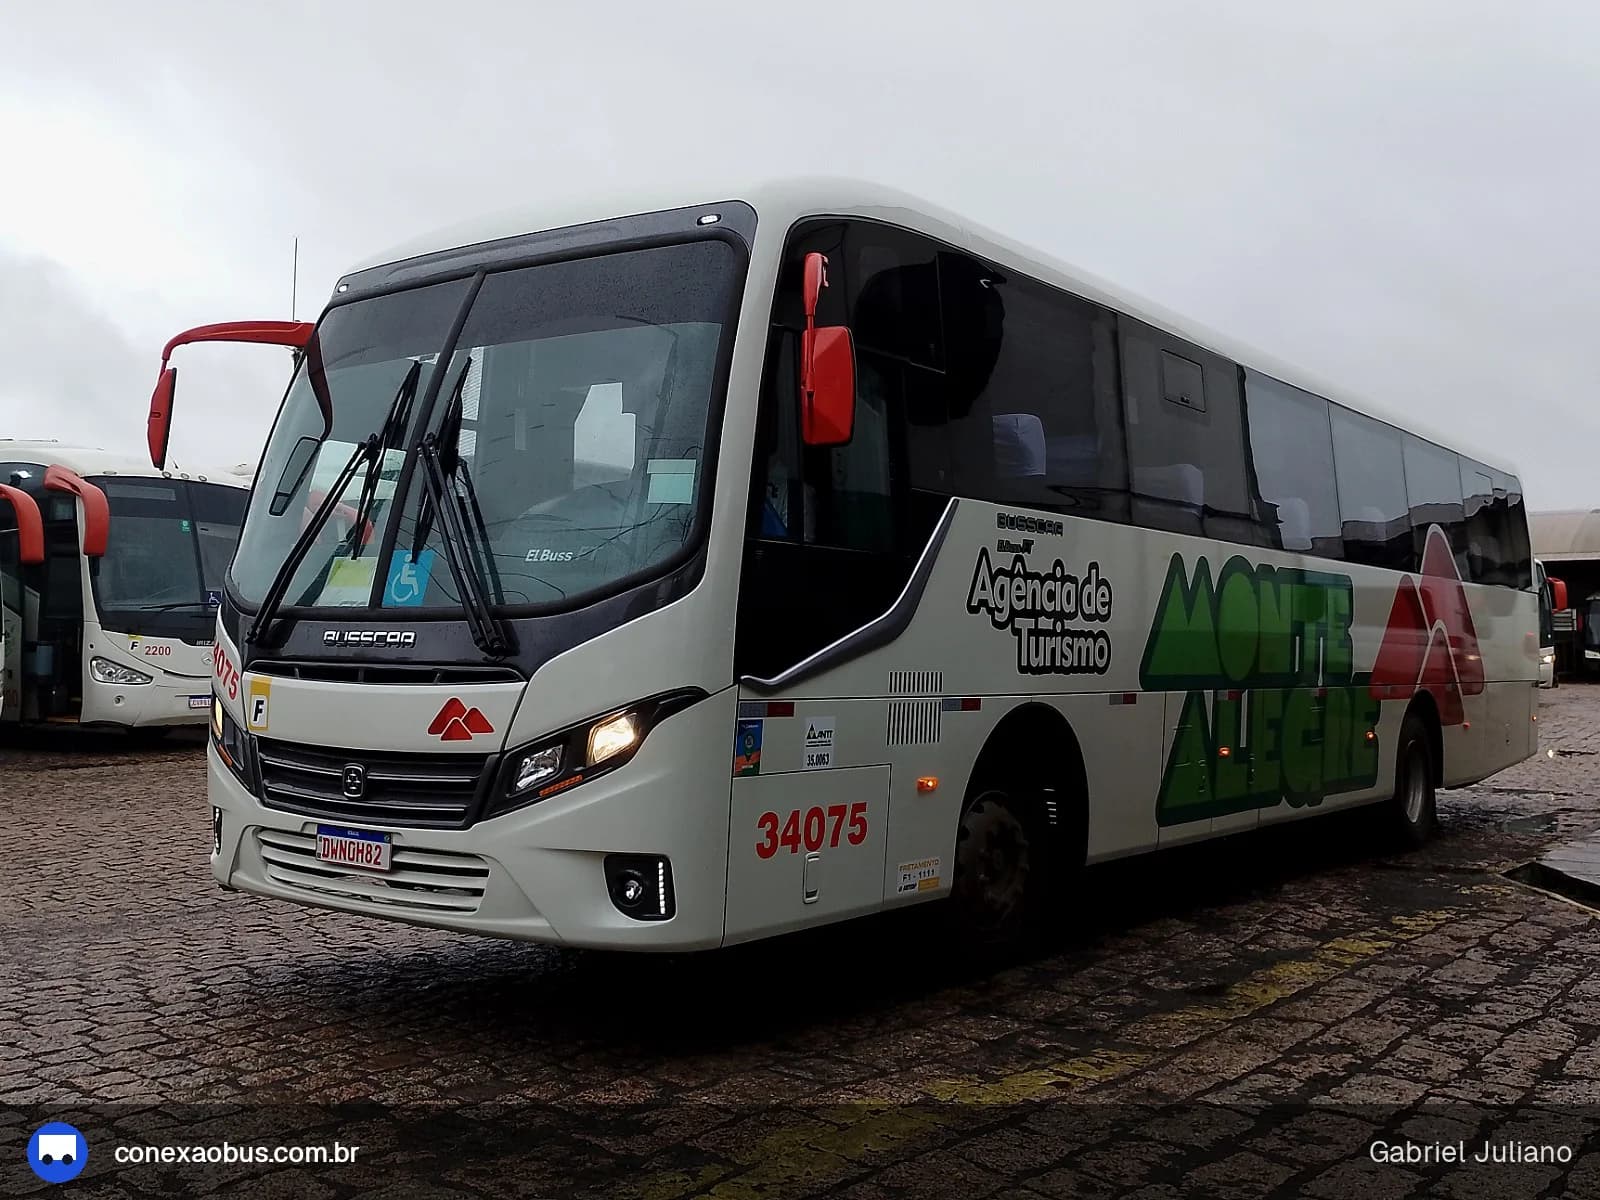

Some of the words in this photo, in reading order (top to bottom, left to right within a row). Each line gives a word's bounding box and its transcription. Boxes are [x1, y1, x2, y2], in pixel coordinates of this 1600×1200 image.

[996, 512, 1064, 536] BUSSCAR
[967, 548, 1079, 629] Agência
[1079, 563, 1112, 622] de
[1139, 552, 1353, 690] MONTE
[130, 641, 139, 650] F
[145, 645, 171, 656] 2200
[323, 630, 416, 648] BUSSCAR
[1012, 617, 1111, 674] Turismo
[253, 699, 265, 722] F
[807, 754, 829, 767] 35.0063
[1156, 674, 1381, 827] ALEGRE
[756, 802, 868, 859] 34075
